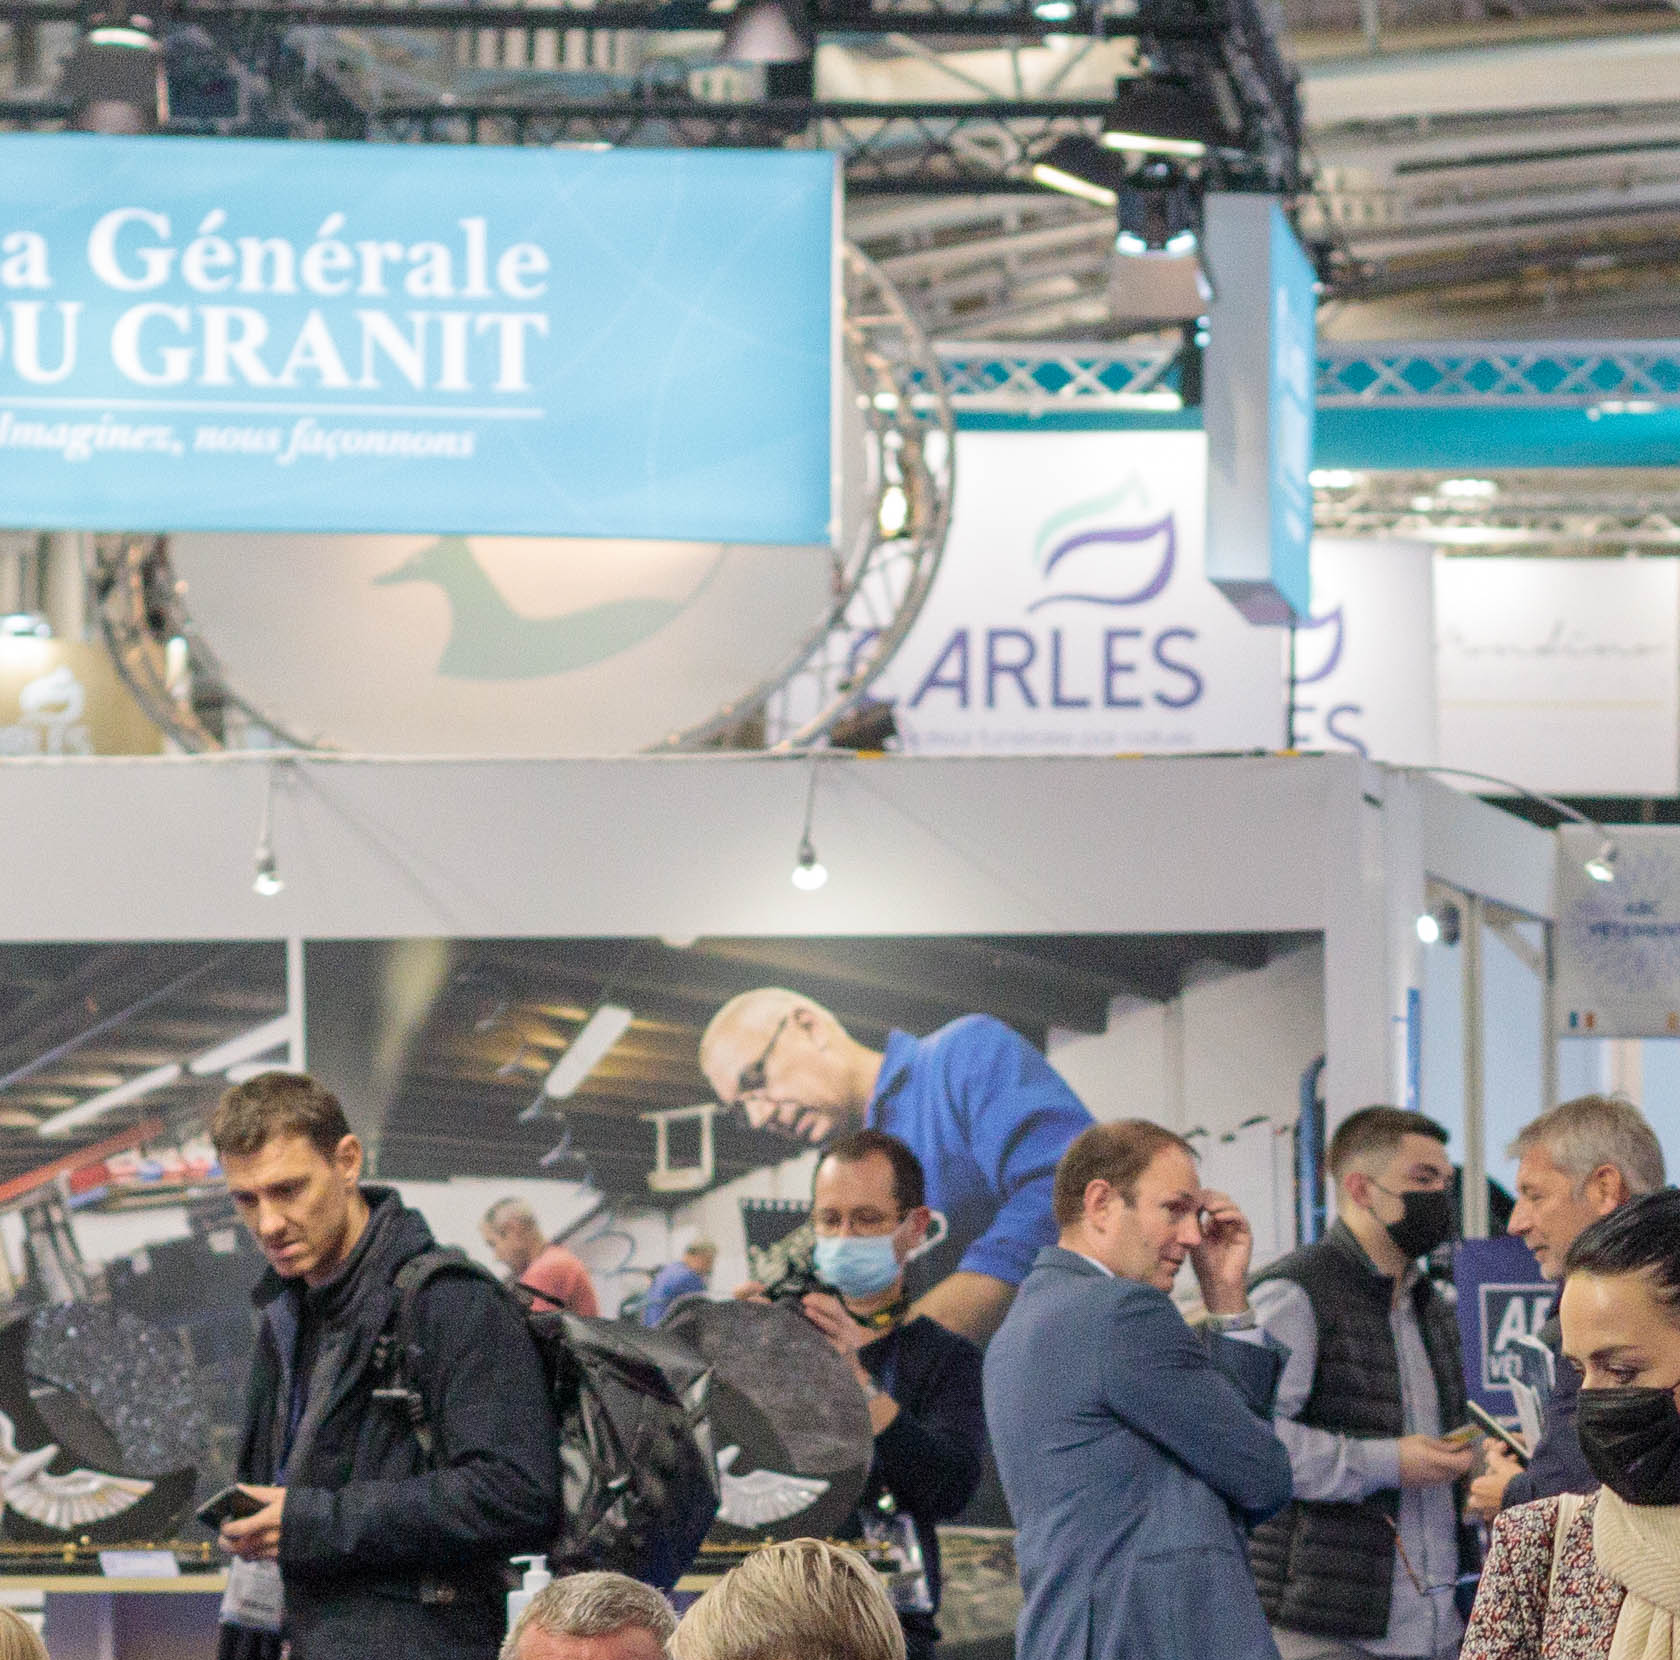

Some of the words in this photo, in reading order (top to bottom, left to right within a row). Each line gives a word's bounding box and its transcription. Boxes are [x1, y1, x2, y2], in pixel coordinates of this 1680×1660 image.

[87, 208, 551, 299] Générale
[111, 302, 550, 393] GRANIT
[194, 423, 281, 456] nous
[274, 417, 477, 467] façonnons
